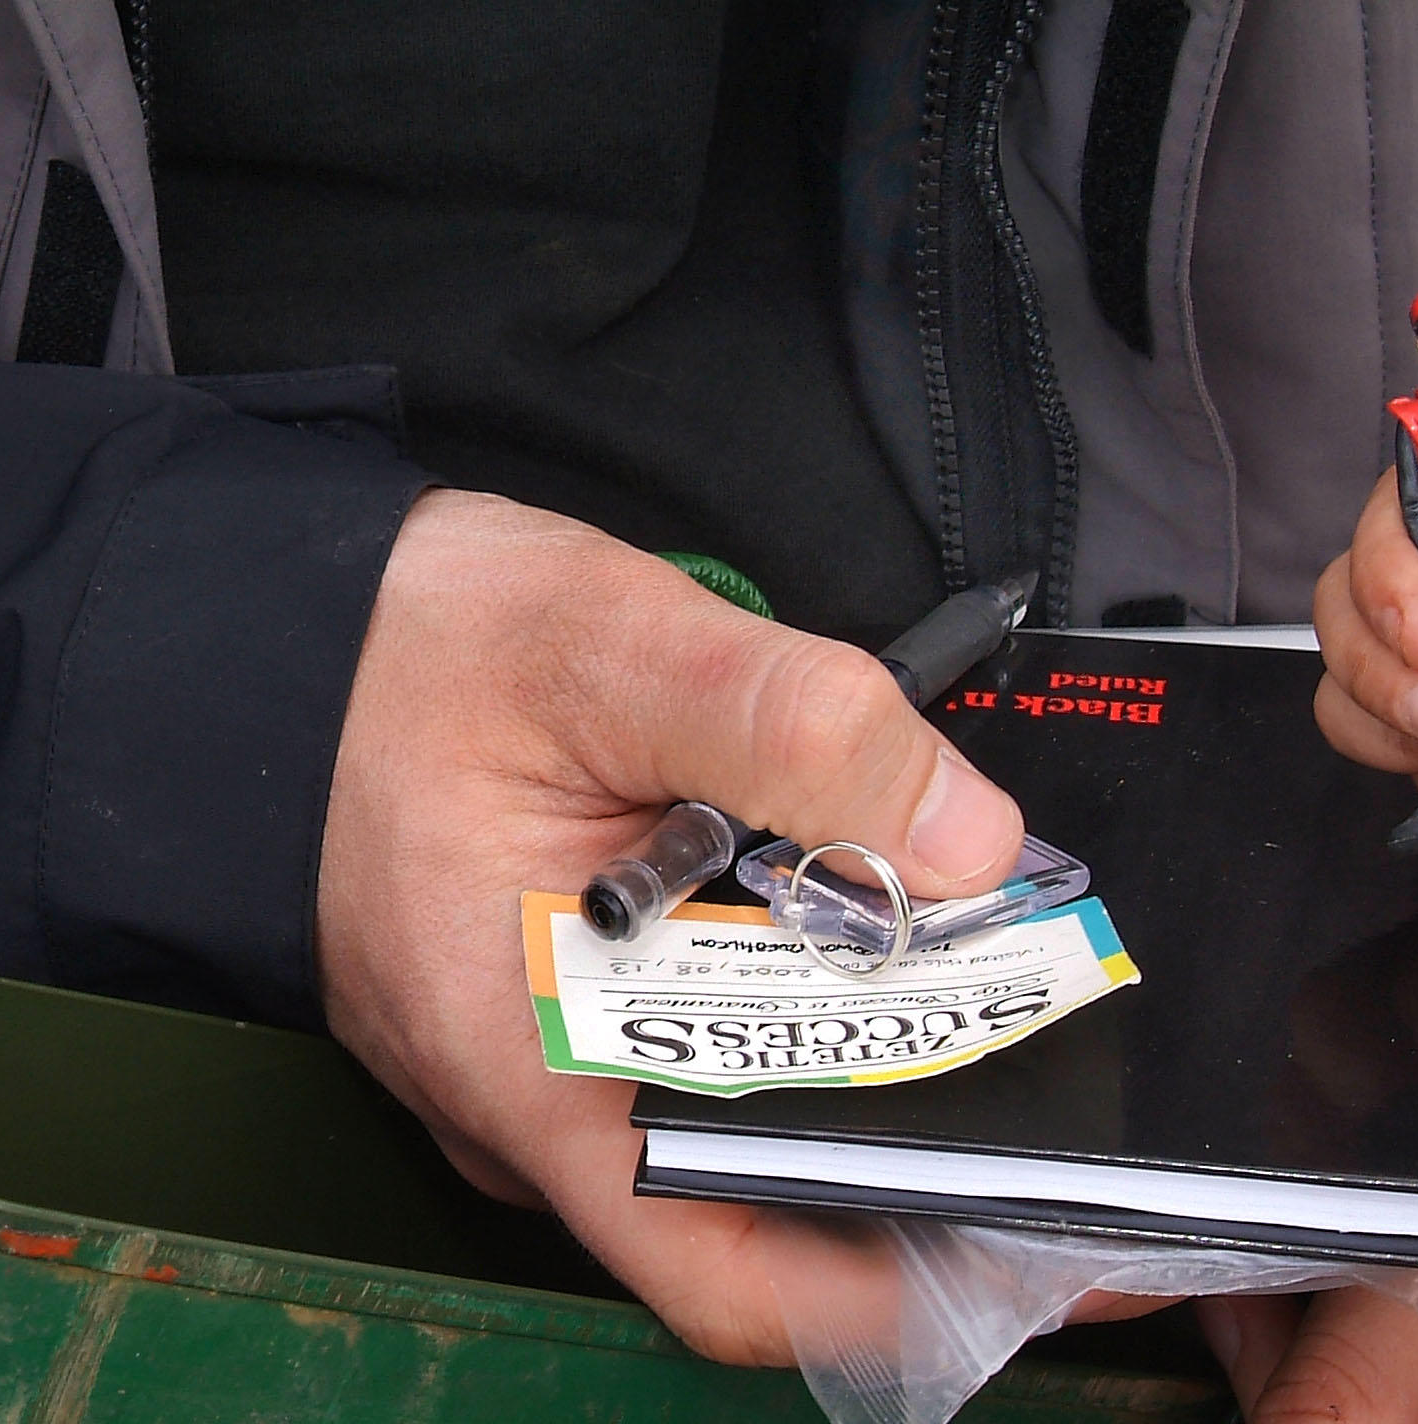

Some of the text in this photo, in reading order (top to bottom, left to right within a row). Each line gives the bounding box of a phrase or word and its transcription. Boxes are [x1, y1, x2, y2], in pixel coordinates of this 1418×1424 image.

[1048, 673, 1167, 696] Ruled
[1014, 694, 1163, 724] Black
[924, 956, 961, 967] this
[969, 949, 1035, 966] visited
[625, 978, 1042, 1013] My Success is Guaranteed
[621, 989, 1052, 1064] SUCCESS
[721, 1031, 957, 1071] ZETETIC
